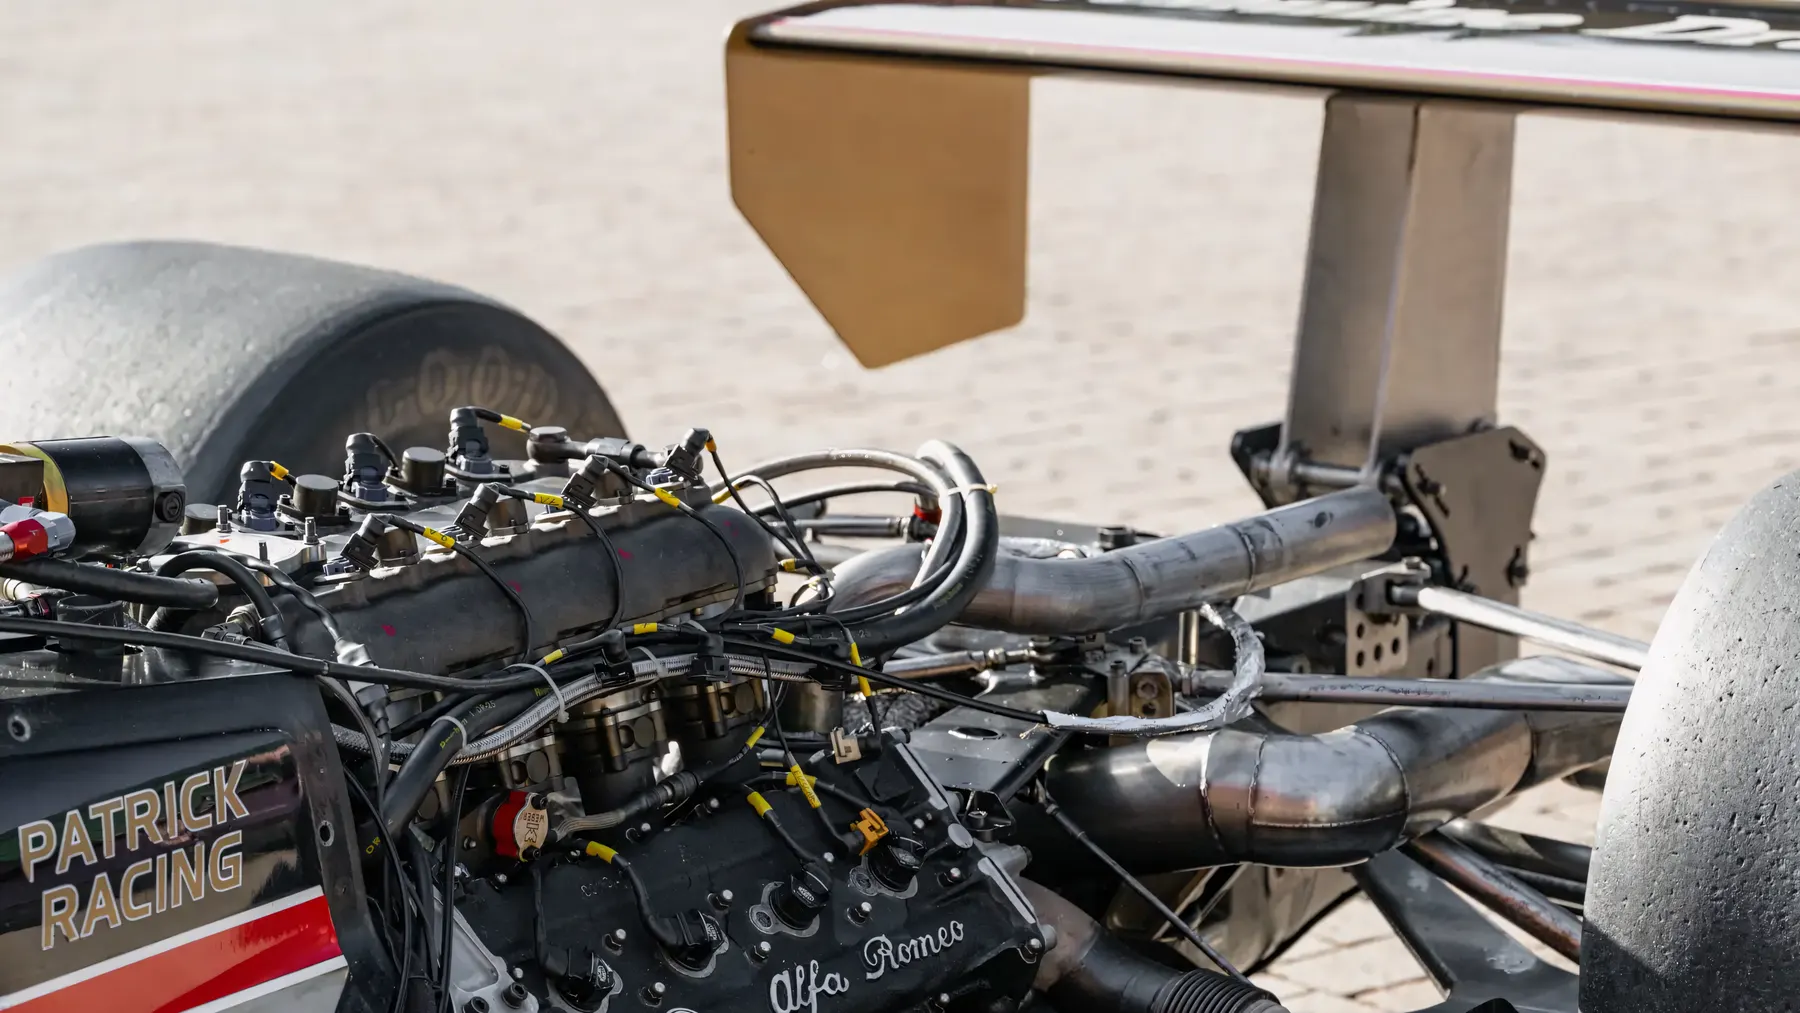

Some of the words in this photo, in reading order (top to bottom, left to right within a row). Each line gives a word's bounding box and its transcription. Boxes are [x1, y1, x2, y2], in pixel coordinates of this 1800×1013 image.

[17, 758, 250, 883] PATRICK
[523, 812, 546, 823] WEBER
[41, 829, 244, 951] RACING
[769, 958, 850, 1013] Alfa
[863, 919, 966, 981] Romeo
